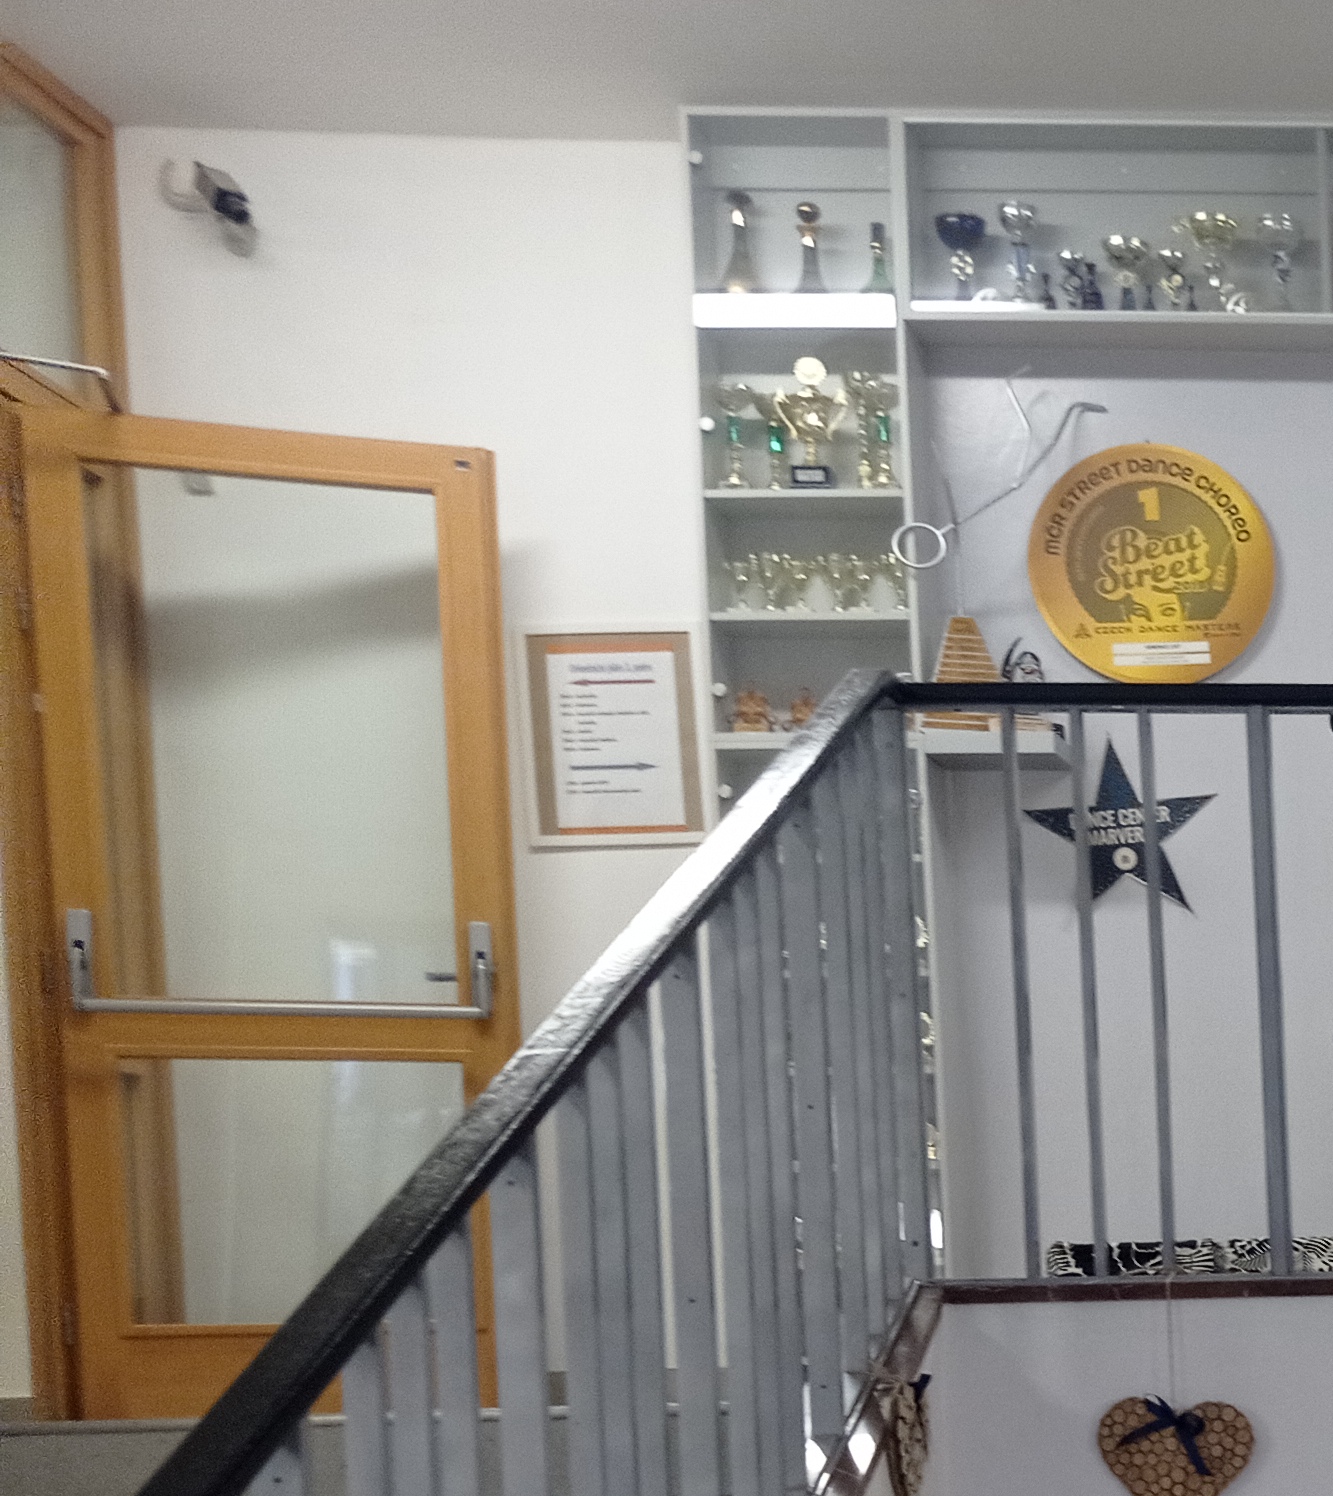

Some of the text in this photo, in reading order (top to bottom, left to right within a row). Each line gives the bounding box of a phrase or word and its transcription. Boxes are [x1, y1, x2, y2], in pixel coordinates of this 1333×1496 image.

[1138, 487, 1162, 521] 1
[1102, 527, 1201, 565] Beat
[1096, 553, 1202, 596] Street
